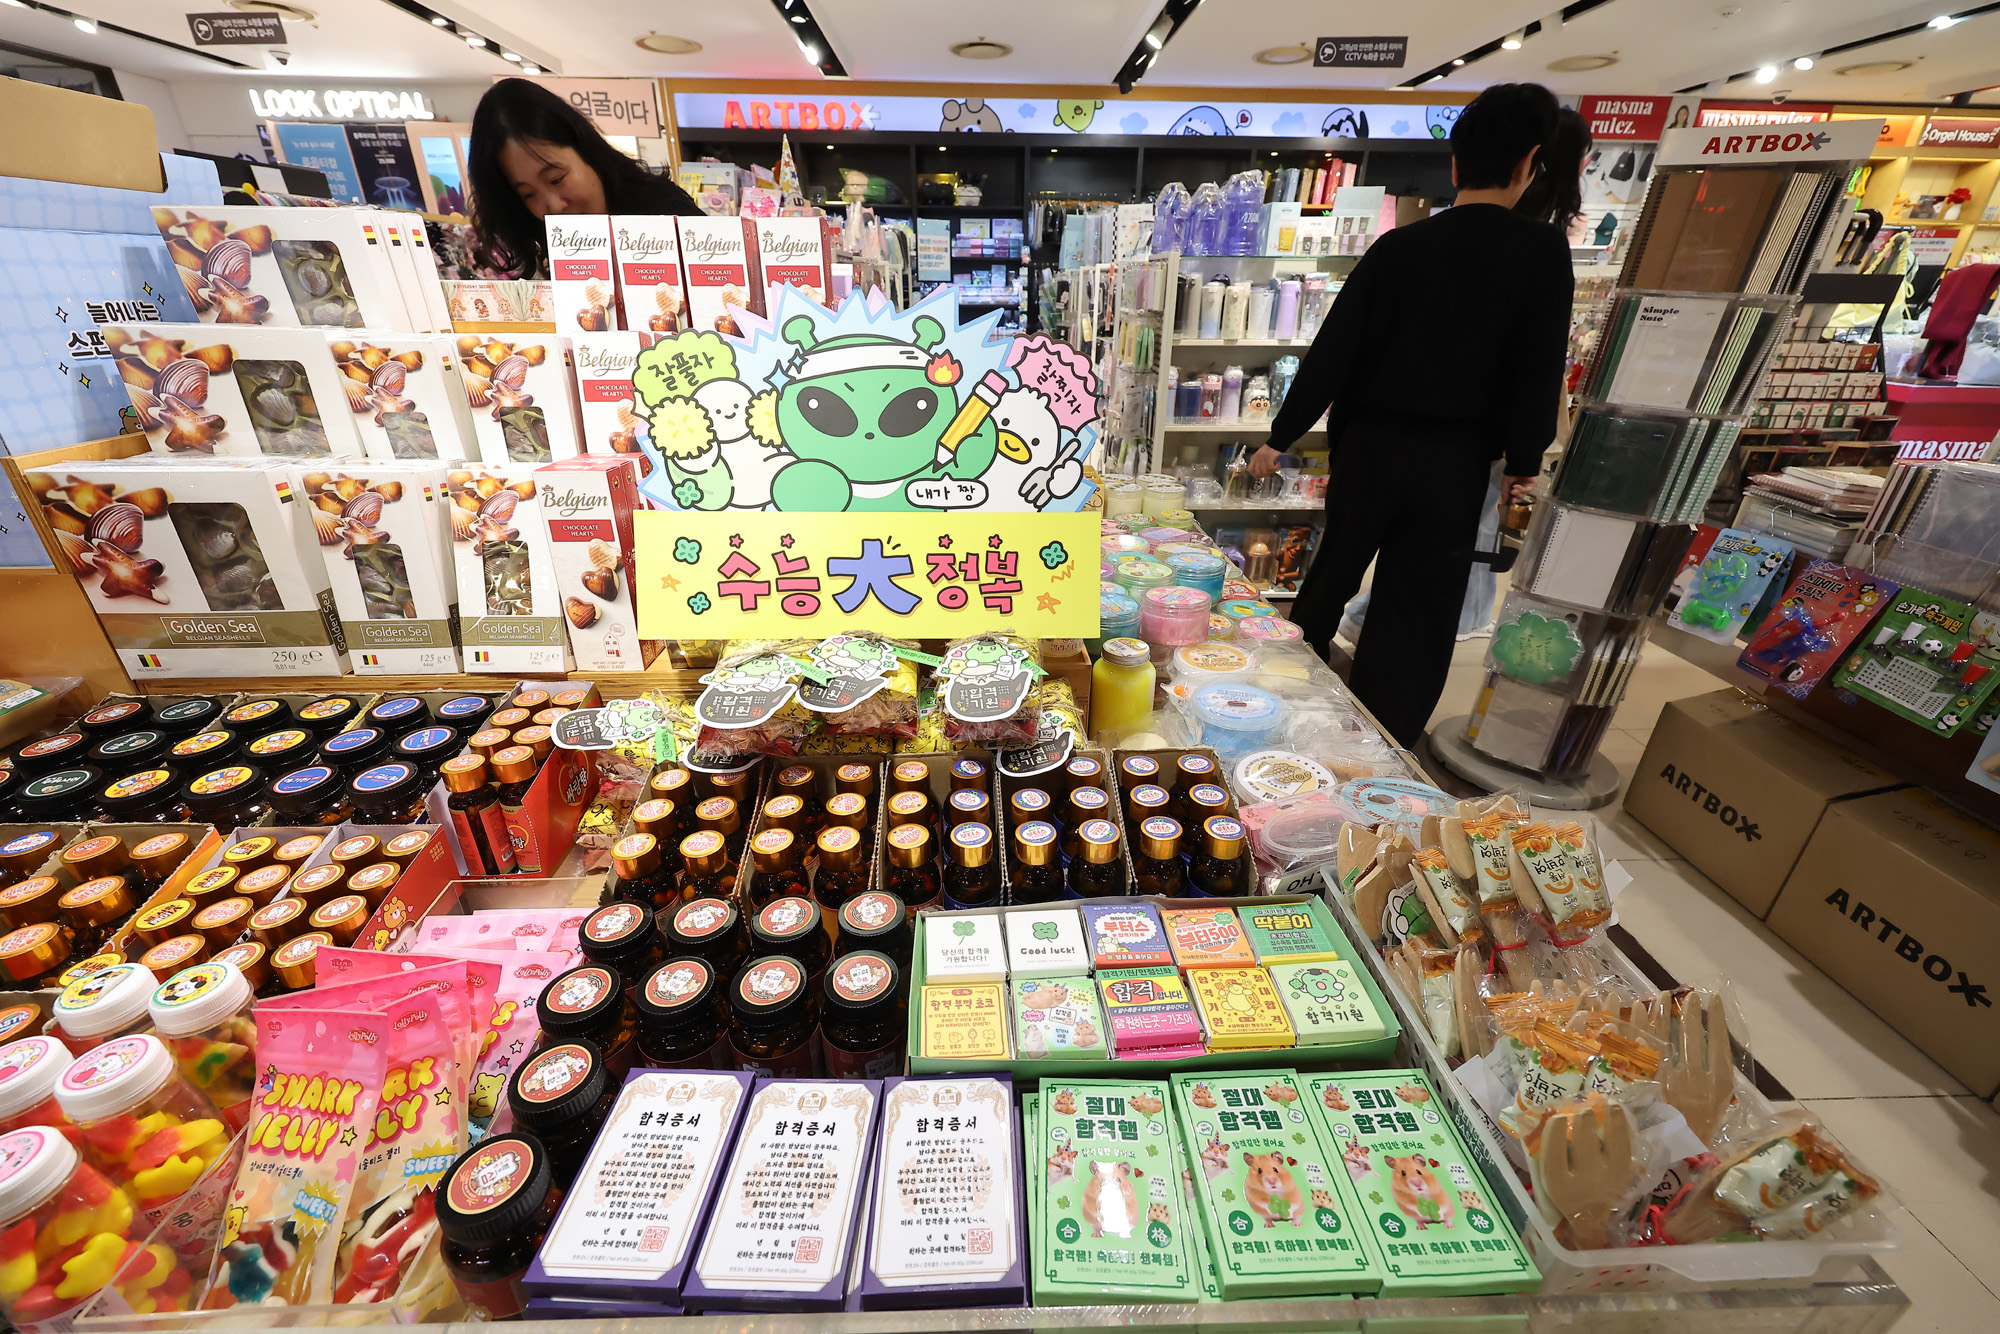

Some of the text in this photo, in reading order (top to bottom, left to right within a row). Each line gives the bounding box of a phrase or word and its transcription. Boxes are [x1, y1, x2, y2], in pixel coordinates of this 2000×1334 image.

[222, 29, 240, 38] CCTV
[1344, 52, 1362, 61] CCTV
[249, 88, 435, 120] LOOK OPTICAL
[1595, 99, 1654, 116] masma
[723, 100, 881, 130] ARTBOX
[1702, 131, 1832, 155] ARTBOX
[1928, 129, 1989, 144] Orgel House
[552, 230, 608, 256] Belgian
[618, 231, 674, 262] Belgian
[684, 232, 741, 262] Belgian
[762, 235, 819, 263] Belgian
[86, 301, 161, 323] 늘어나는
[1640, 315, 1664, 323] Note
[1642, 306, 1680, 315] Simple
[648, 351, 714, 391] 잘풀자
[1034, 359, 1082, 417] 잘찍자
[916, 484, 976, 502] 내가 짱
[544, 491, 608, 519] Belgian
[570, 530, 594, 538] HEARTS
[1794, 584, 1827, 601] 슈팅건
[1802, 574, 1846, 595] 스파이더
[321, 593, 347, 652] Golden Sea
[1896, 600, 1964, 634] 손가락 축구게임
[170, 620, 258, 634] Golden Sea
[365, 626, 429, 638] Golden Sea
[482, 622, 542, 634] Golden Sea
[272, 651, 296, 663] 250
[419, 653, 435, 662] 125
[529, 652, 543, 660] 125
[969, 686, 998, 698] 합격
[970, 698, 999, 710] 기원
[1659, 762, 1762, 842] ARTBOX
[1532, 854, 1566, 875] 호박엿
[1549, 868, 1566, 883] 전통
[1104, 920, 1150, 932] 부터스
[1253, 914, 1313, 931] 딱붙어
[1176, 924, 1240, 952] 부터500
[942, 948, 964, 956] 당신의
[1050, 946, 1076, 954] luck!
[1824, 887, 1993, 1008] ARTBOX
[946, 956, 988, 964] 기원합니다!
[1110, 980, 1184, 1003] 합격 합니다!
[930, 1000, 952, 1012] 합격
[976, 998, 994, 1008] 초코
[1305, 1009, 1364, 1025] 합격기원
[262, 1072, 362, 1118] SHARK
[1220, 1087, 1264, 1108] 절대
[1352, 1088, 1397, 1109] 절대
[1085, 1096, 1126, 1116] 절대
[639, 1111, 701, 1128] 합격증서
[775, 1120, 836, 1136] 합격증서
[916, 1116, 977, 1133] 합격증서
[1216, 1110, 1284, 1132] 합격햄
[1352, 1112, 1420, 1134] 합격햄
[250, 1112, 340, 1157] JELLY
[1075, 1118, 1139, 1142] 합격햄
[250, 1161, 275, 1174] 상어모양
[294, 1190, 338, 1224] SWEET!
[1232, 1216, 1249, 1232] 合
[1320, 1212, 1337, 1229] 格
[1384, 1218, 1401, 1234] 合
[1471, 1214, 1490, 1230] 格
[1061, 1224, 1077, 1239] 合
[1150, 1226, 1167, 1242] 格
